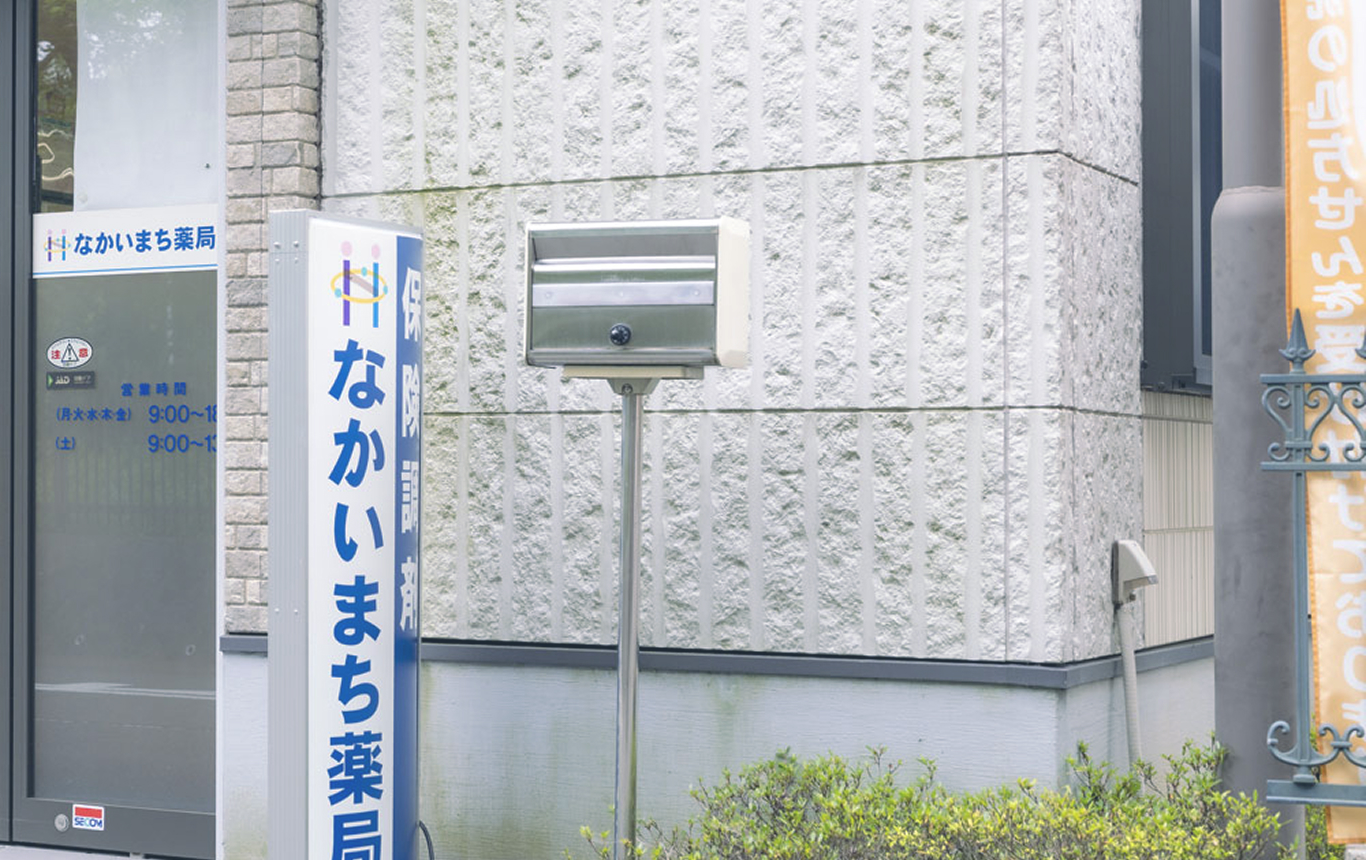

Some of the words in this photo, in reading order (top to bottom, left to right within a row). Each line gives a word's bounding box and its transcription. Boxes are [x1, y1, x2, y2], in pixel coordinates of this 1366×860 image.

[74, 226, 215, 255] なかいまち薬局
[121, 382, 187, 397] 営業時間
[55, 436, 76, 450] (土)
[400, 266, 422, 635] 保険調剤
[327, 338, 385, 860] なかいまち薬局
[74, 816, 103, 828] SECOM
